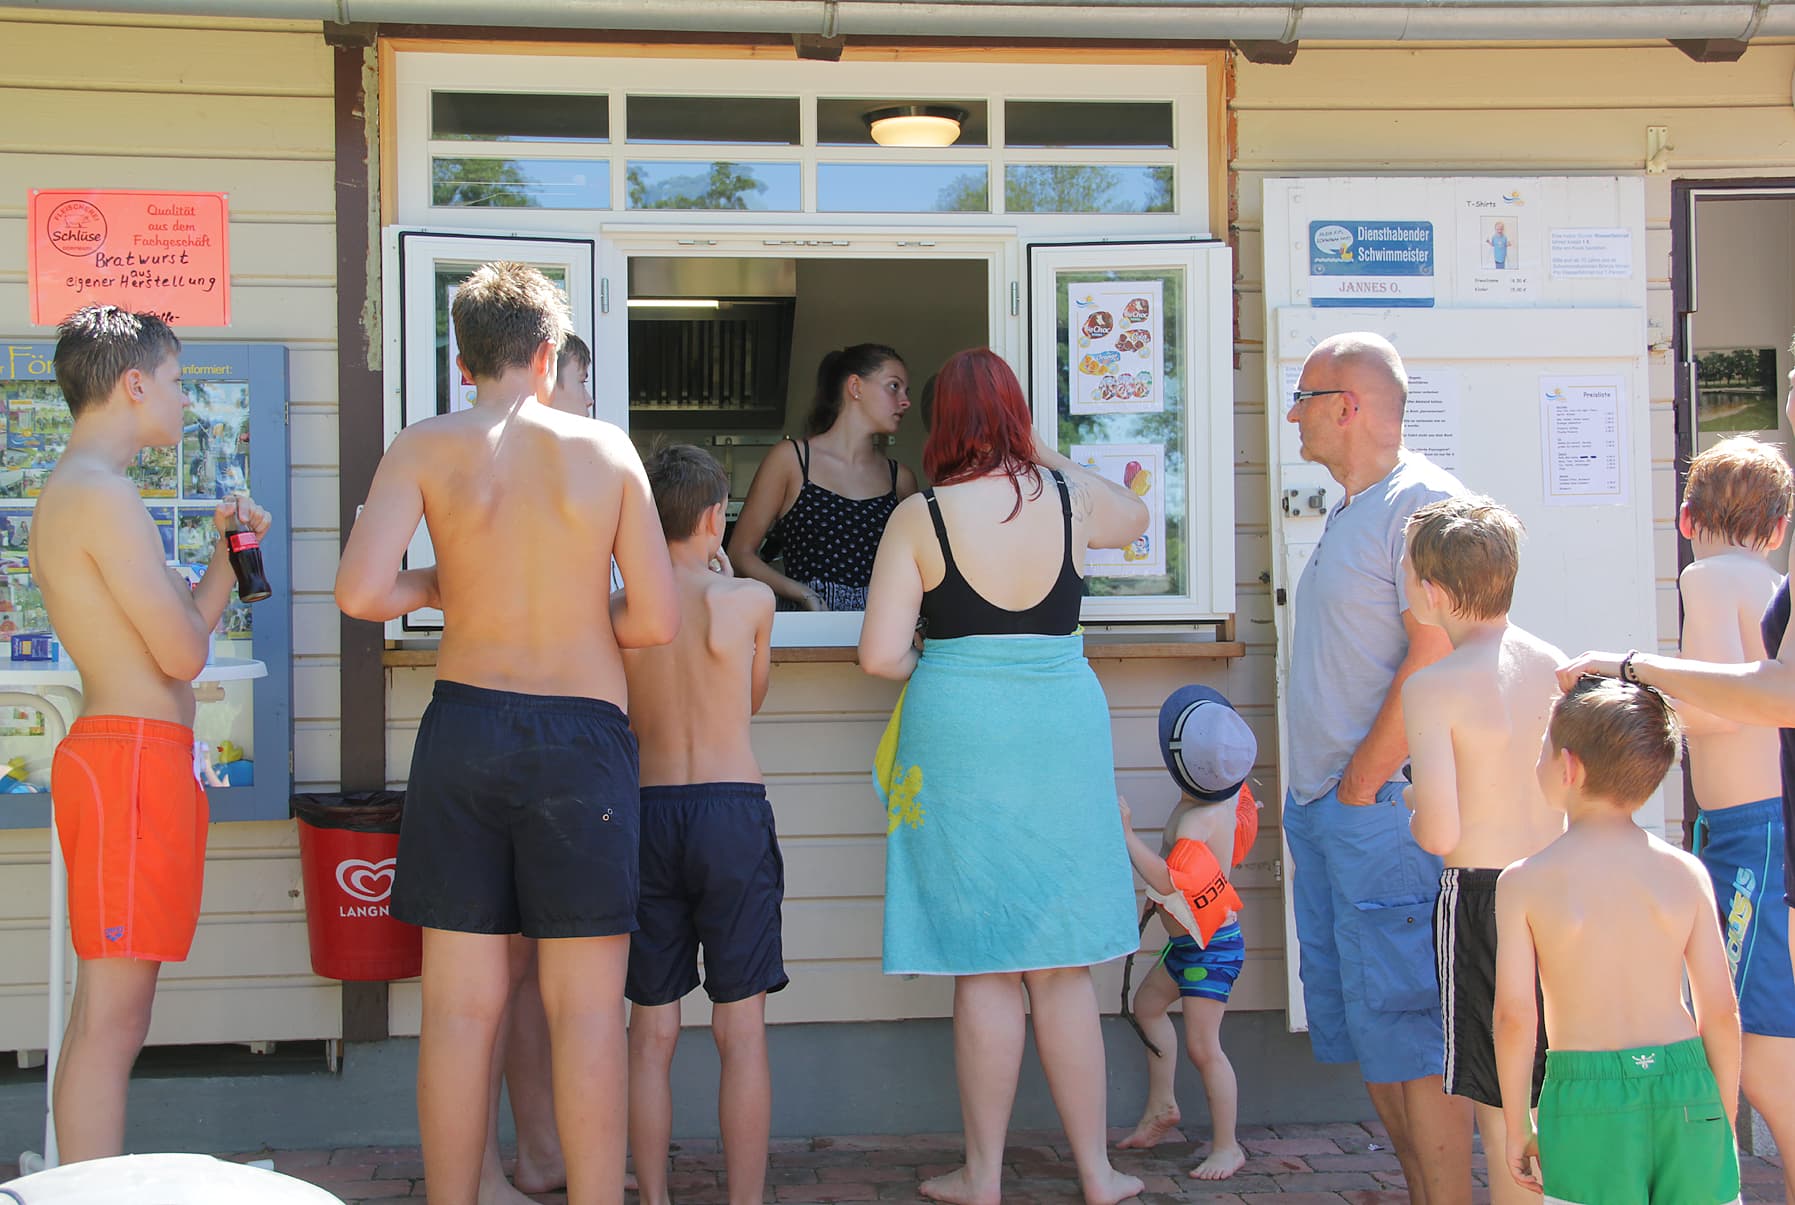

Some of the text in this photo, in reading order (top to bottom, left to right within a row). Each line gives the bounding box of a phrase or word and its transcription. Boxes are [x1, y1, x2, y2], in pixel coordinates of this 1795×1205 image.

[147, 204, 196, 216] Qualität
[1466, 200, 1496, 208] T-Shirts
[148, 221, 196, 231] aus dem
[52, 230, 102, 242] Schlüse
[1357, 226, 1429, 241] Diensthabender
[133, 234, 211, 249] Fachgeschäft
[95, 250, 189, 268] Bratwurst
[1358, 247, 1429, 262] Schwimmeister
[130, 270, 152, 278] aus
[66, 276, 216, 293] eigener Herstellung
[1339, 282, 1401, 293] JANNES O.
[8, 346, 54, 379] För
[1194, 872, 1227, 909] ECO
[340, 905, 390, 917] LANGN
